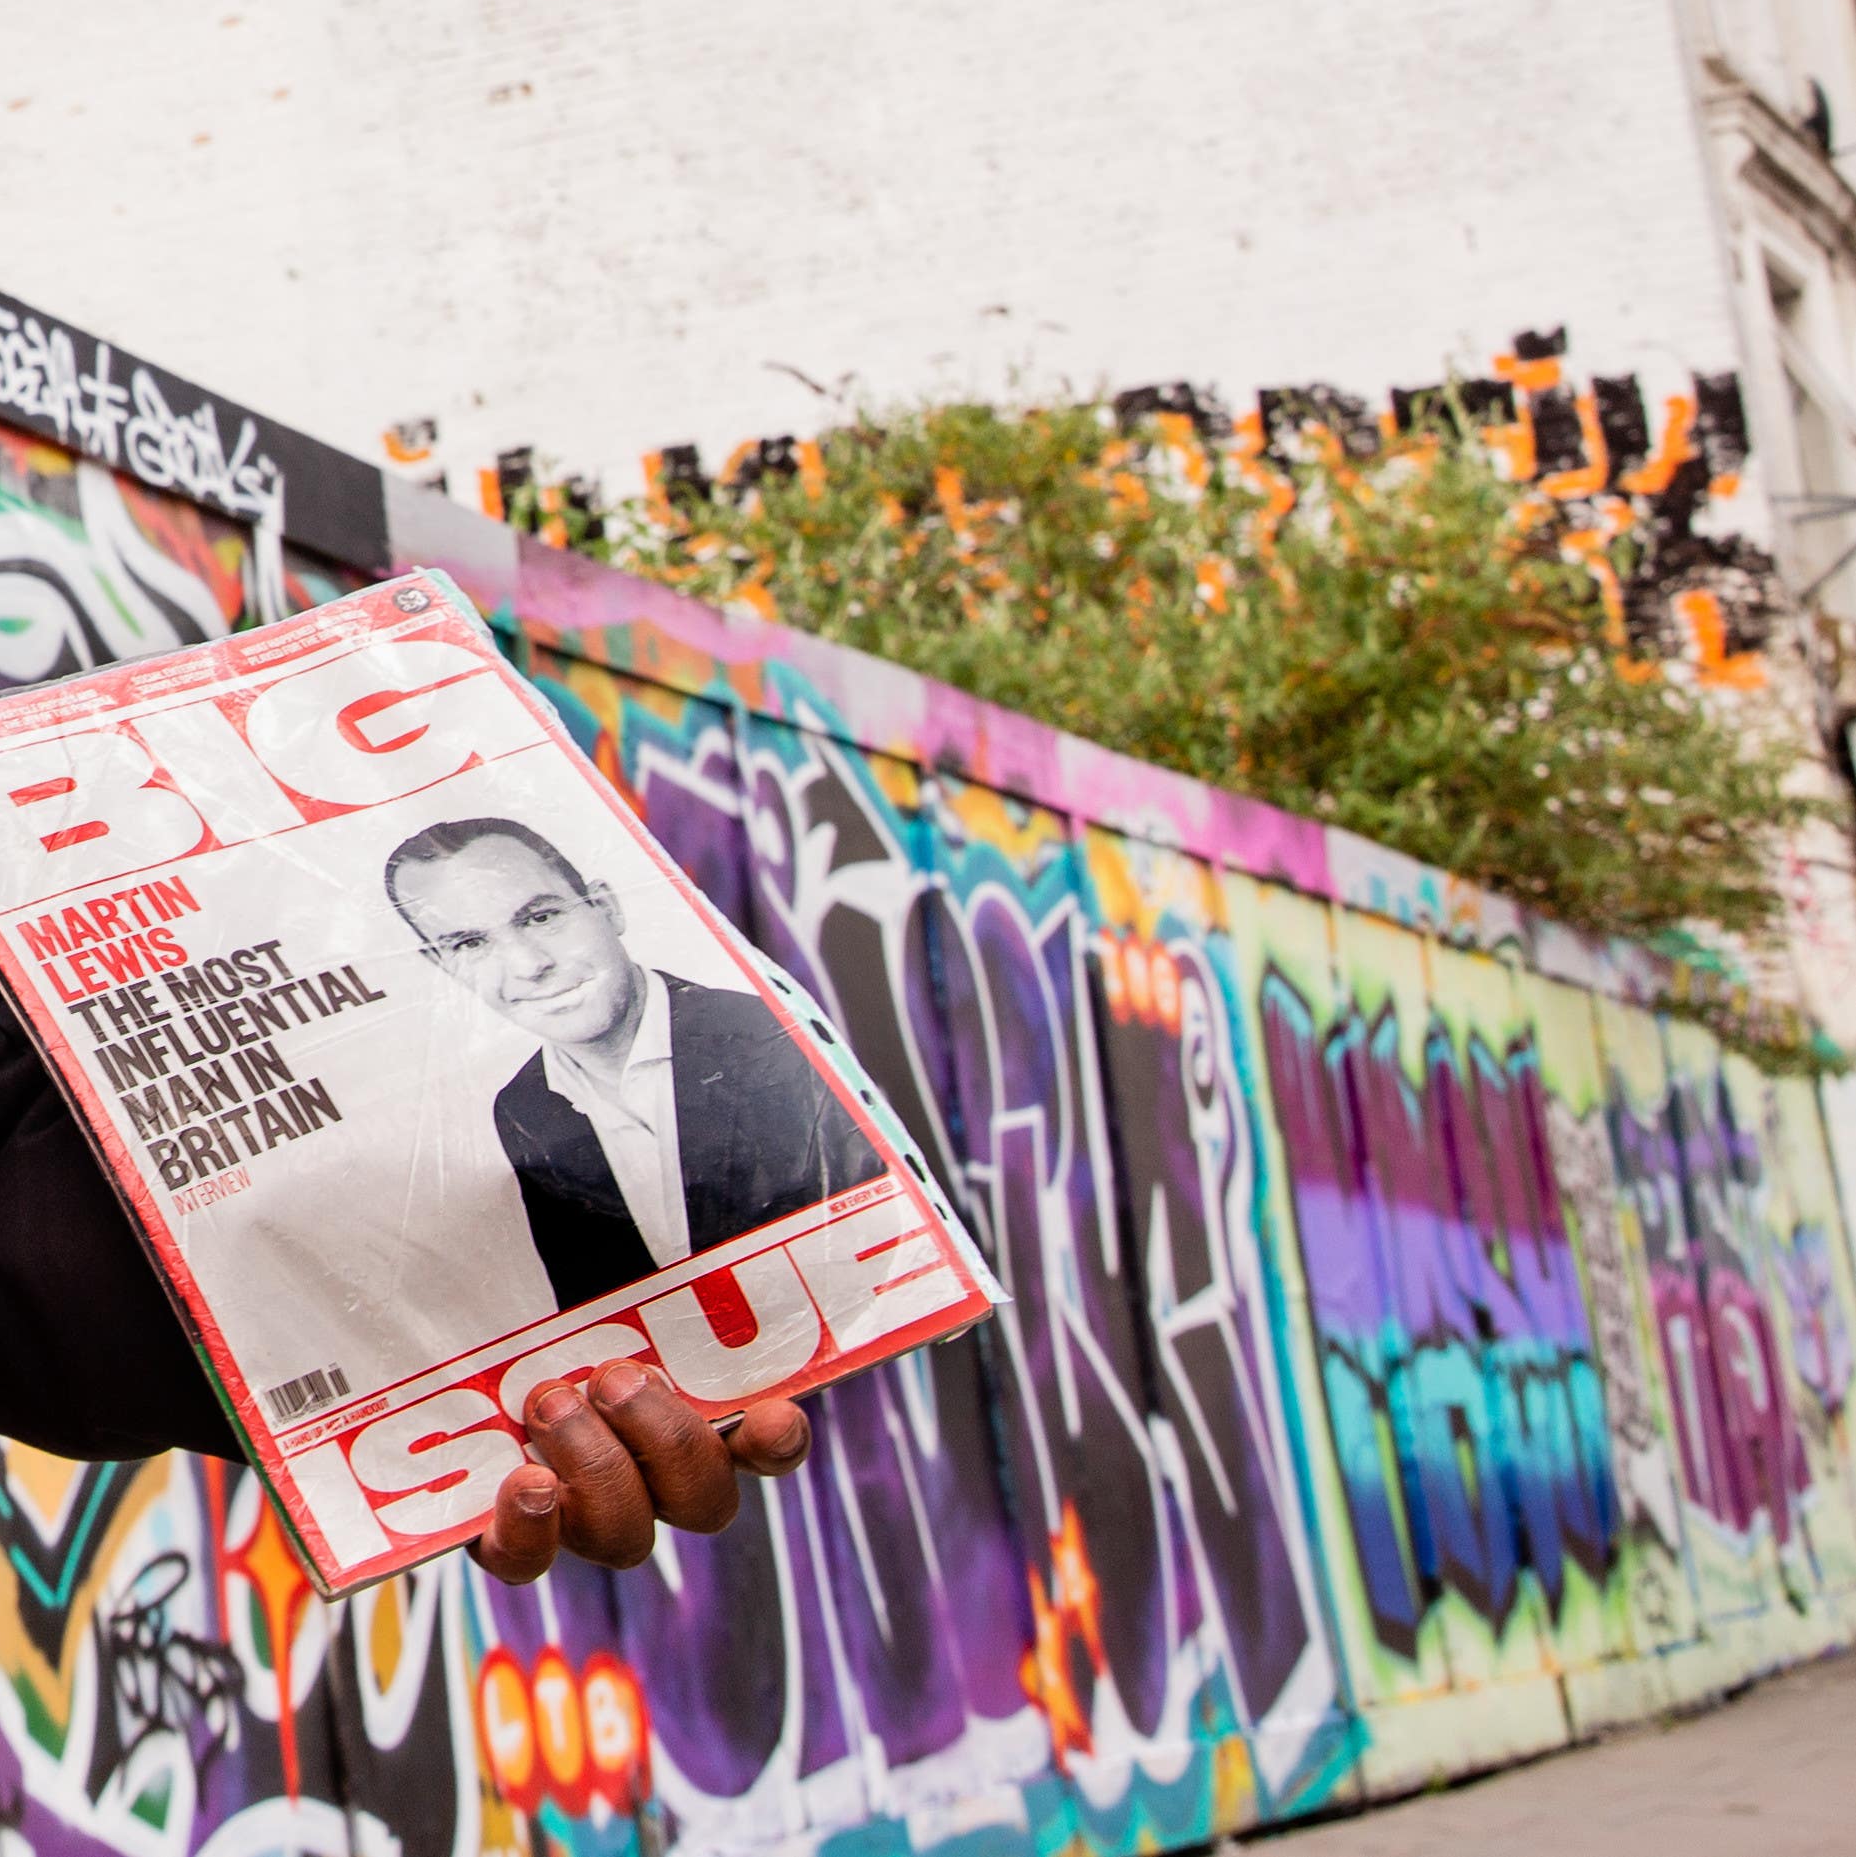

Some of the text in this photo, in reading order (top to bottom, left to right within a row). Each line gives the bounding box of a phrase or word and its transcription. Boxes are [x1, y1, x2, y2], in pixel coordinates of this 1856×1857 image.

[16, 875, 201, 962] MARTIN
[41, 927, 188, 1004] LEWIS
[68, 940, 295, 1044] THE MOST
[93, 965, 388, 1094] INFLUENTIAL
[119, 1040, 296, 1142] MAN IN
[146, 1077, 343, 1192] BRITAIN
[170, 1166, 253, 1217] INTERVIEW
[287, 1199, 970, 1569] ISSUE
